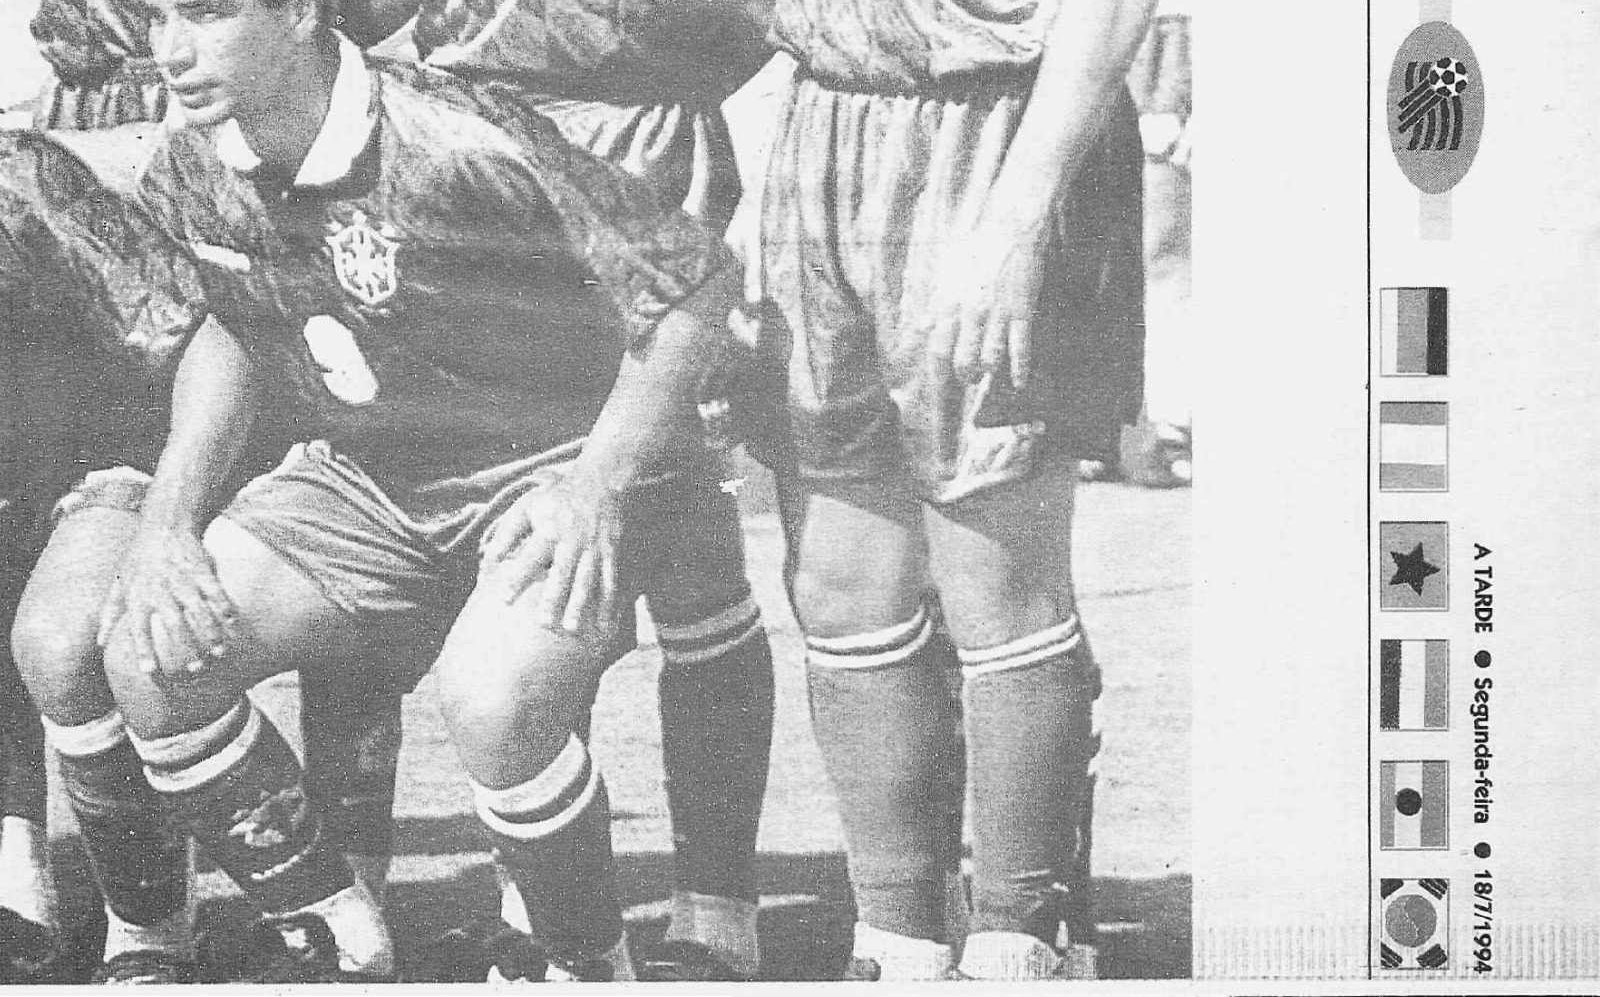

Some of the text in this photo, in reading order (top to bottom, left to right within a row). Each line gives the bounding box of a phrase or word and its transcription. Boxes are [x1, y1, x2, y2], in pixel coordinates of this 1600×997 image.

[1473, 542, 1493, 634] A TARDE
[1469, 677, 1494, 824] Segunda-feira
[1472, 869, 1493, 976] 18/7/1994
